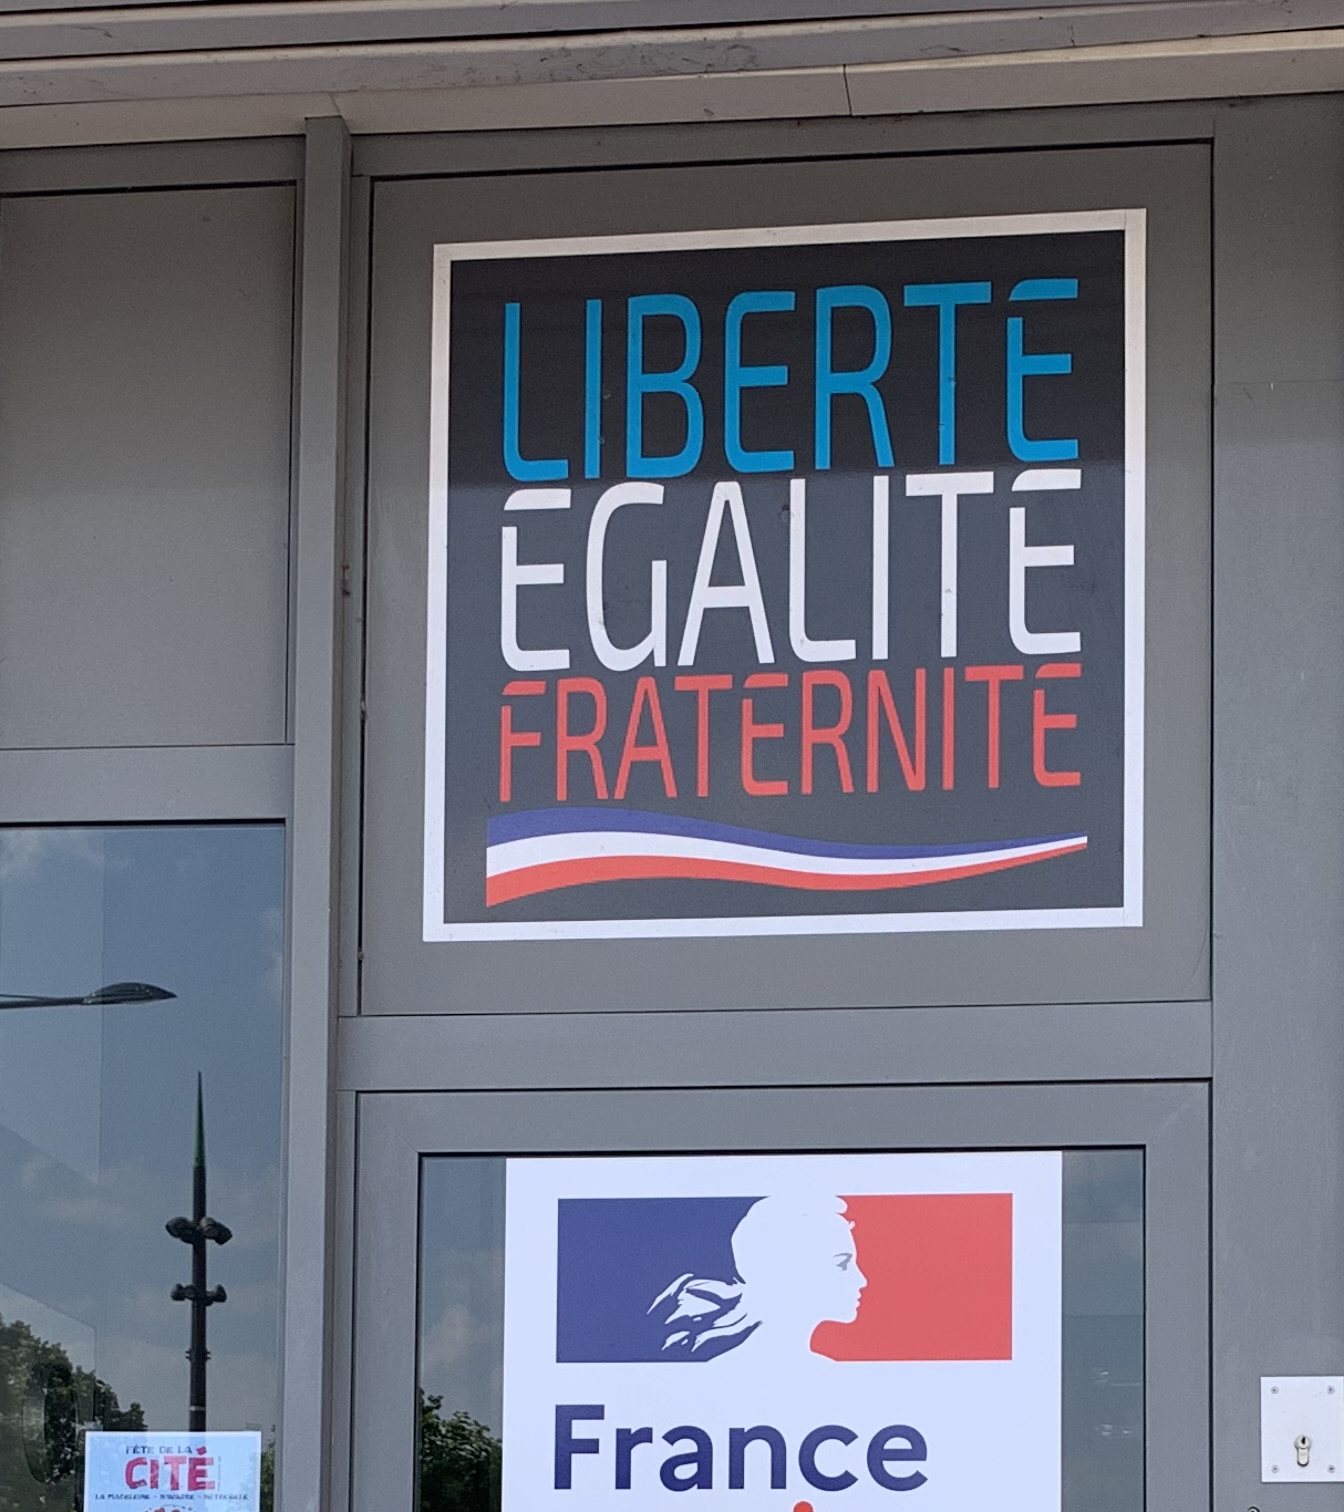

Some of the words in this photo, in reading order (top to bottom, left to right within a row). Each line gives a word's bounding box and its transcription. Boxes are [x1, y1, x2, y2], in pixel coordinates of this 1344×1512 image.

[125, 1446, 215, 1491] CITÉ
[178, 1446, 193, 1454] LA
[554, 1404, 928, 1491] France
